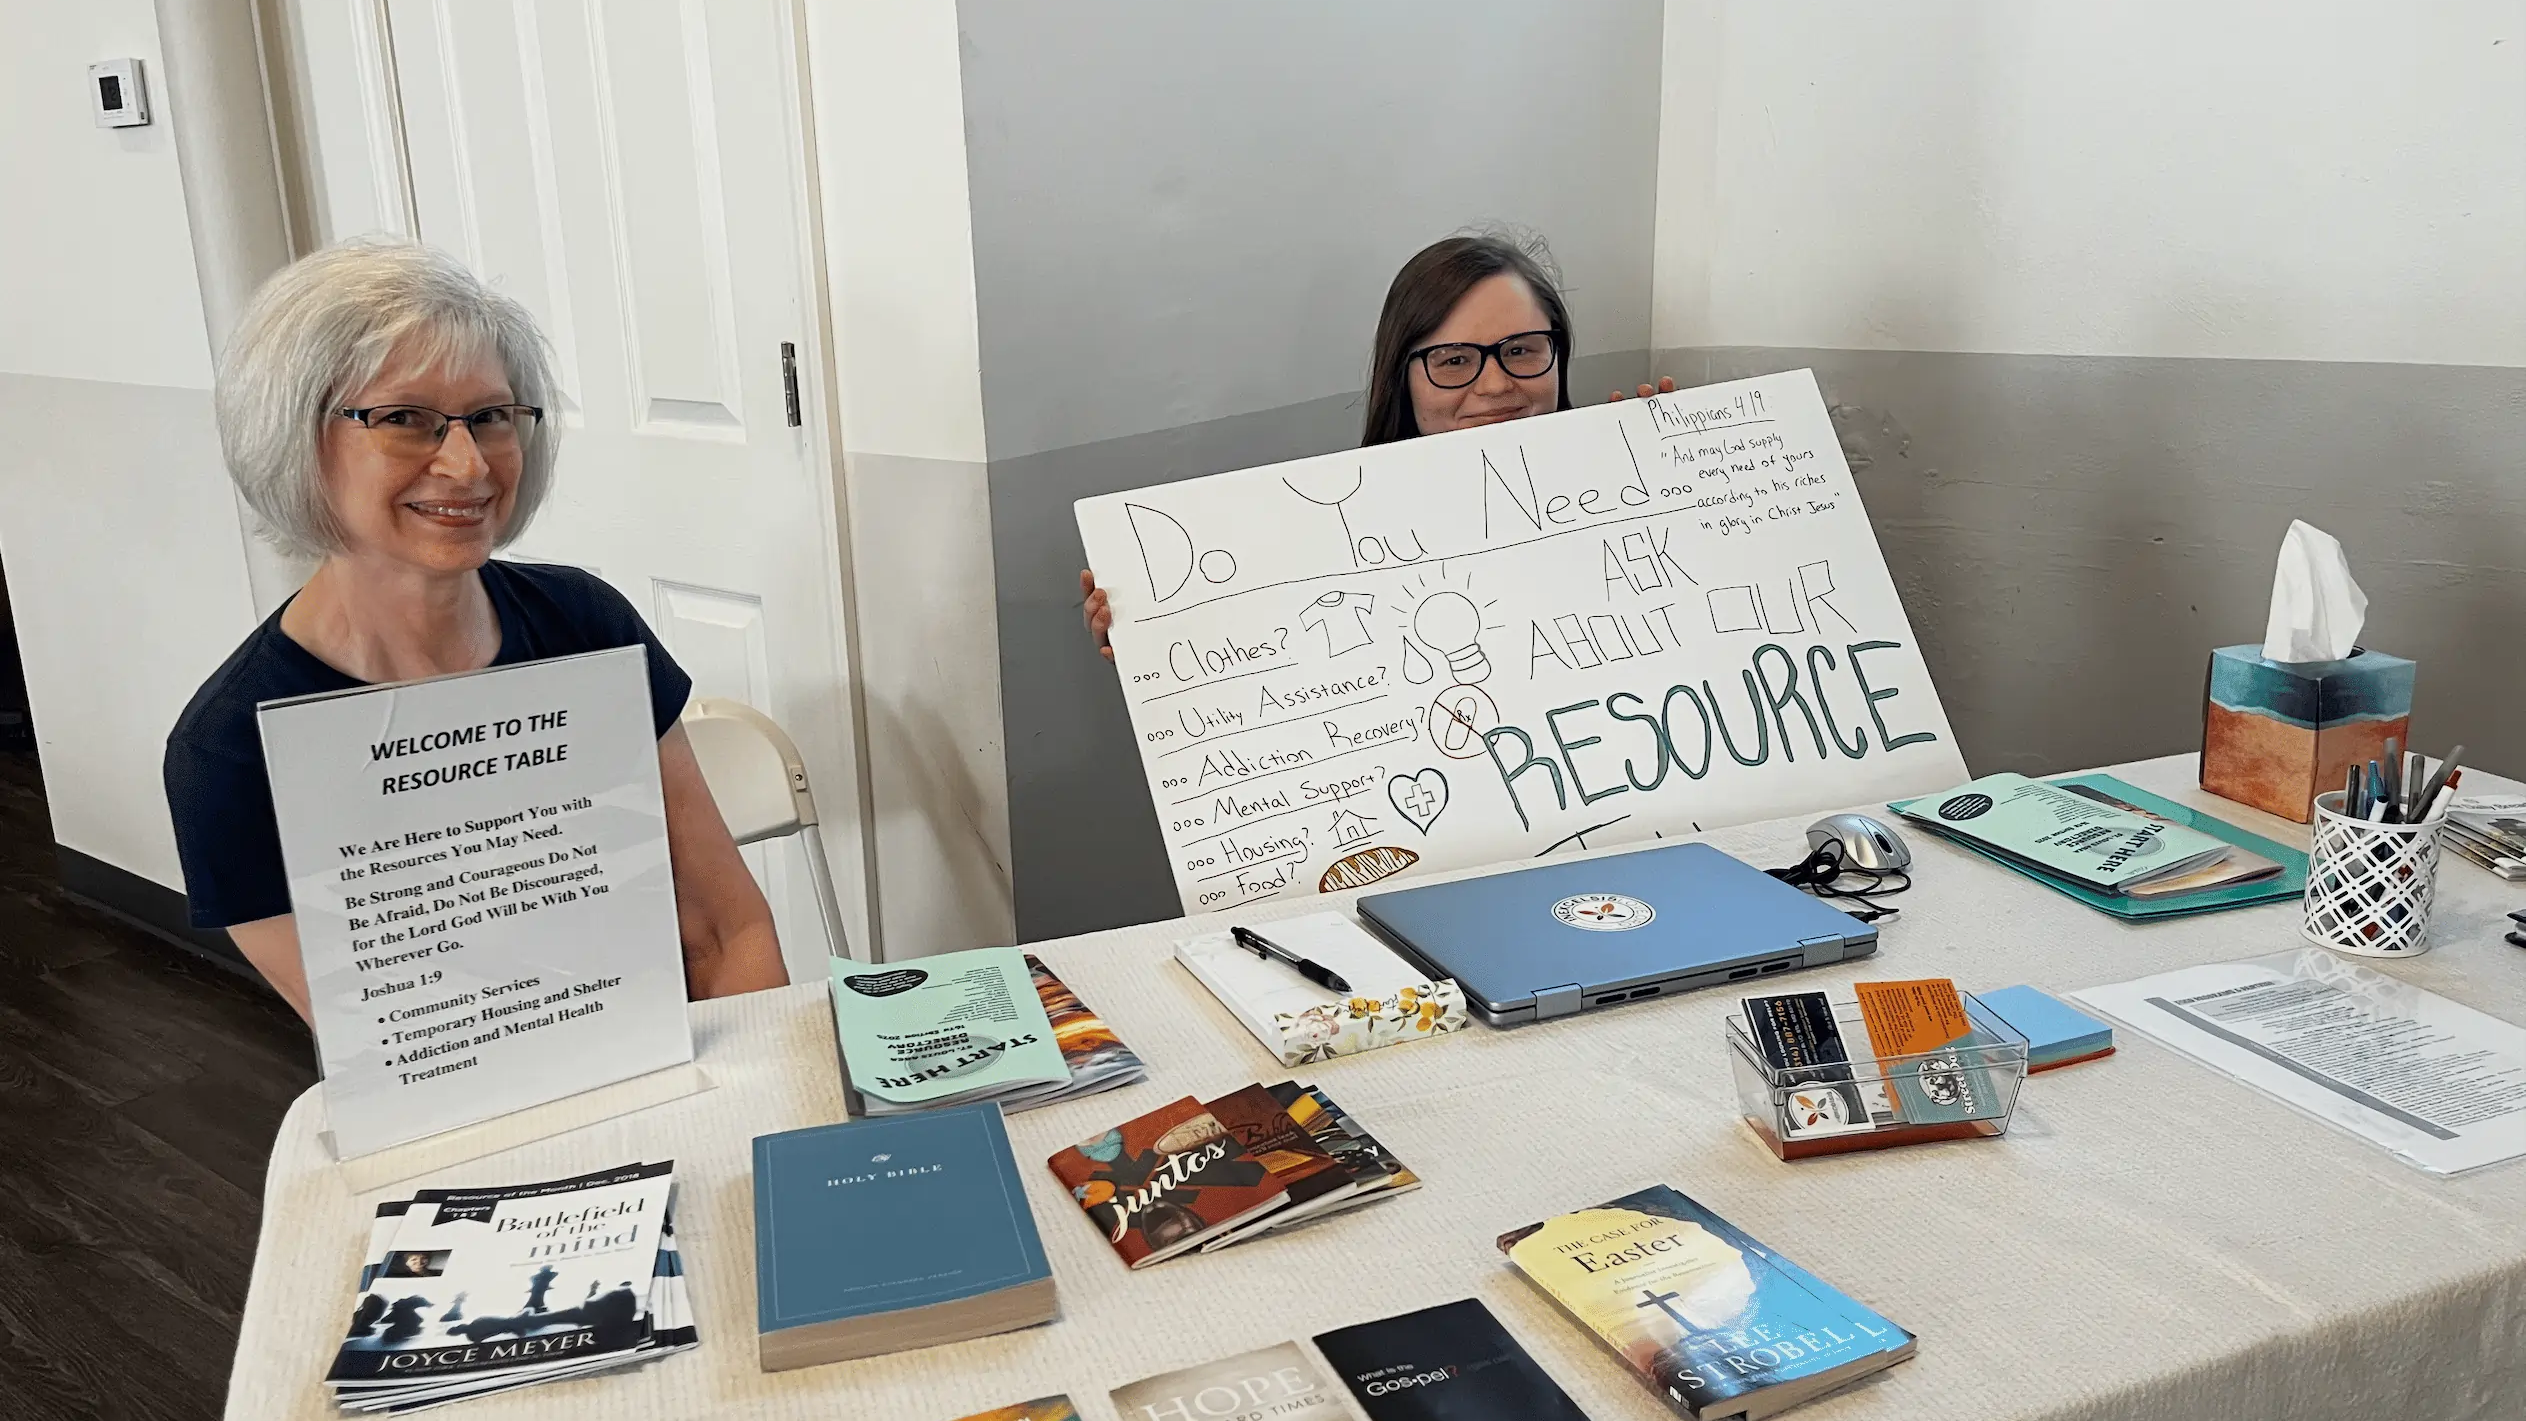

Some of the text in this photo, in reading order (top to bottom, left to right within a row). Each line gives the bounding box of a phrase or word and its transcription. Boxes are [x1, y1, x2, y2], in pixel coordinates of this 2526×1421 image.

[1647, 398, 1732, 434] Philippians
[1734, 396, 1746, 417] 4
[1698, 447, 1722, 462] may
[1723, 439, 1746, 453] God
[1749, 433, 1784, 451] supply
[1698, 450, 1815, 484] every need of yours
[1697, 472, 1827, 508] according to his riches
[1125, 503, 1237, 603] Do
[1282, 465, 1429, 568] You
[1698, 518, 1713, 530] in
[1719, 515, 1751, 536] glory
[1751, 512, 1763, 524] in
[1768, 504, 1802, 520] Christ
[1603, 526, 1699, 602] ASK
[1530, 560, 1858, 680] ABOUT OUR
[1168, 627, 1291, 684] Clothes?
[1178, 666, 1390, 738] Utility Assistance?
[371, 710, 568, 762] WELCOME TO THE
[1198, 706, 1425, 787] Addiction Recovery?
[1483, 640, 1937, 832] RESOURCE
[382, 744, 568, 795] RESOURCE TABLE
[1213, 765, 1386, 824] Mental Support?
[339, 797, 592, 858] We Are Here to Support You with
[1220, 827, 1314, 864] Housing?
[2096, 823, 2164, 872] START HERE
[340, 824, 563, 882] the Resources You May Need.
[345, 844, 598, 910] Be Strong and Courageous Do Not
[349, 863, 604, 931] Be Afraid, Do Not Be Discouraged,
[1235, 862, 1301, 895] Food?
[352, 884, 610, 953] for the Lord God Will be With You
[355, 940, 464, 973] Wherever Go.
[361, 970, 443, 1002] Joshua 1:9
[389, 976, 541, 1023] Community Services
[392, 976, 622, 1045] Temporary Housing and Shelter
[396, 1001, 604, 1066] Addiction and Mental Health
[887, 1033, 968, 1049] DIRECTORY
[897, 1039, 970, 1055] RESOURCE
[399, 1056, 478, 1085] Treatment
[875, 1034, 1038, 1088] START HERE
[1953, 1075, 1976, 1115] Street
[446, 1192, 501, 1201] Resource
[518, 1188, 538, 1197] the
[540, 1184, 577, 1195] Month
[827, 1163, 943, 1187] HOLY BIBLE
[1111, 1138, 1227, 1243] juntos
[443, 1204, 491, 1214] Chapters
[496, 1198, 645, 1233] Battlefield
[529, 1224, 638, 1258] mind
[536, 1223, 607, 1239] of the
[1552, 1218, 1664, 1254] THE CASE FOR
[1570, 1234, 1685, 1274] Easter
[377, 1347, 480, 1373] JOYCE
[489, 1332, 597, 1360] MEYER
[1143, 1366, 1315, 1421] HOPE
[1357, 1364, 1414, 1383] What is the
[1271, 1393, 1326, 1417] TIMES
